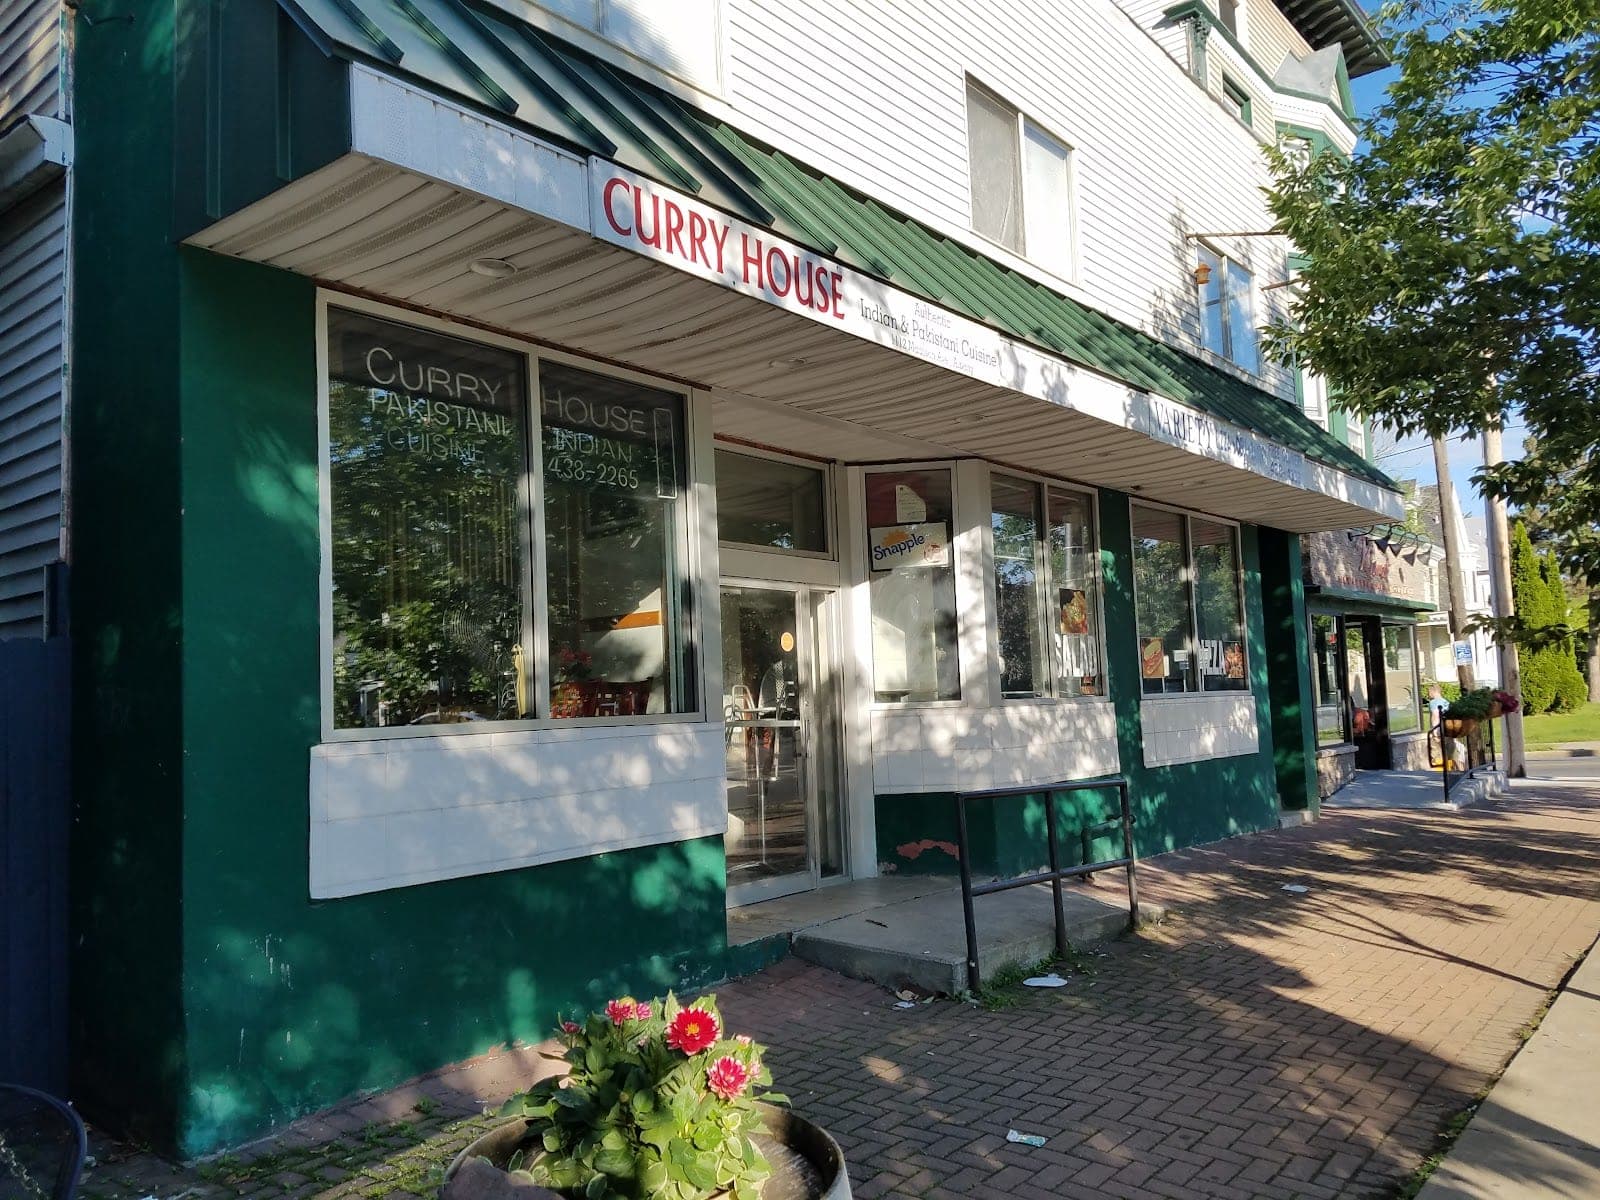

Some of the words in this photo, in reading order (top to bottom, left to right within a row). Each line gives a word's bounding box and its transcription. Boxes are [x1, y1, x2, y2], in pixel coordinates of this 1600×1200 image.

[603, 177, 729, 274] CURRY
[741, 231, 845, 320] HOUSE
[859, 298, 898, 330] Indian
[900, 315, 909, 335] &
[912, 319, 960, 355] Pakistani
[961, 339, 997, 368] Cuisine
[366, 347, 502, 405] CURRY
[541, 386, 646, 435] HOUSE
[371, 387, 510, 436] PAKISTANI
[555, 428, 632, 463] INDIAN
[1154, 400, 1213, 450] VARIETY
[548, 457, 638, 489] 438-2265
[873, 533, 925, 561] Snapple
[1055, 633, 1097, 678] SALAD
